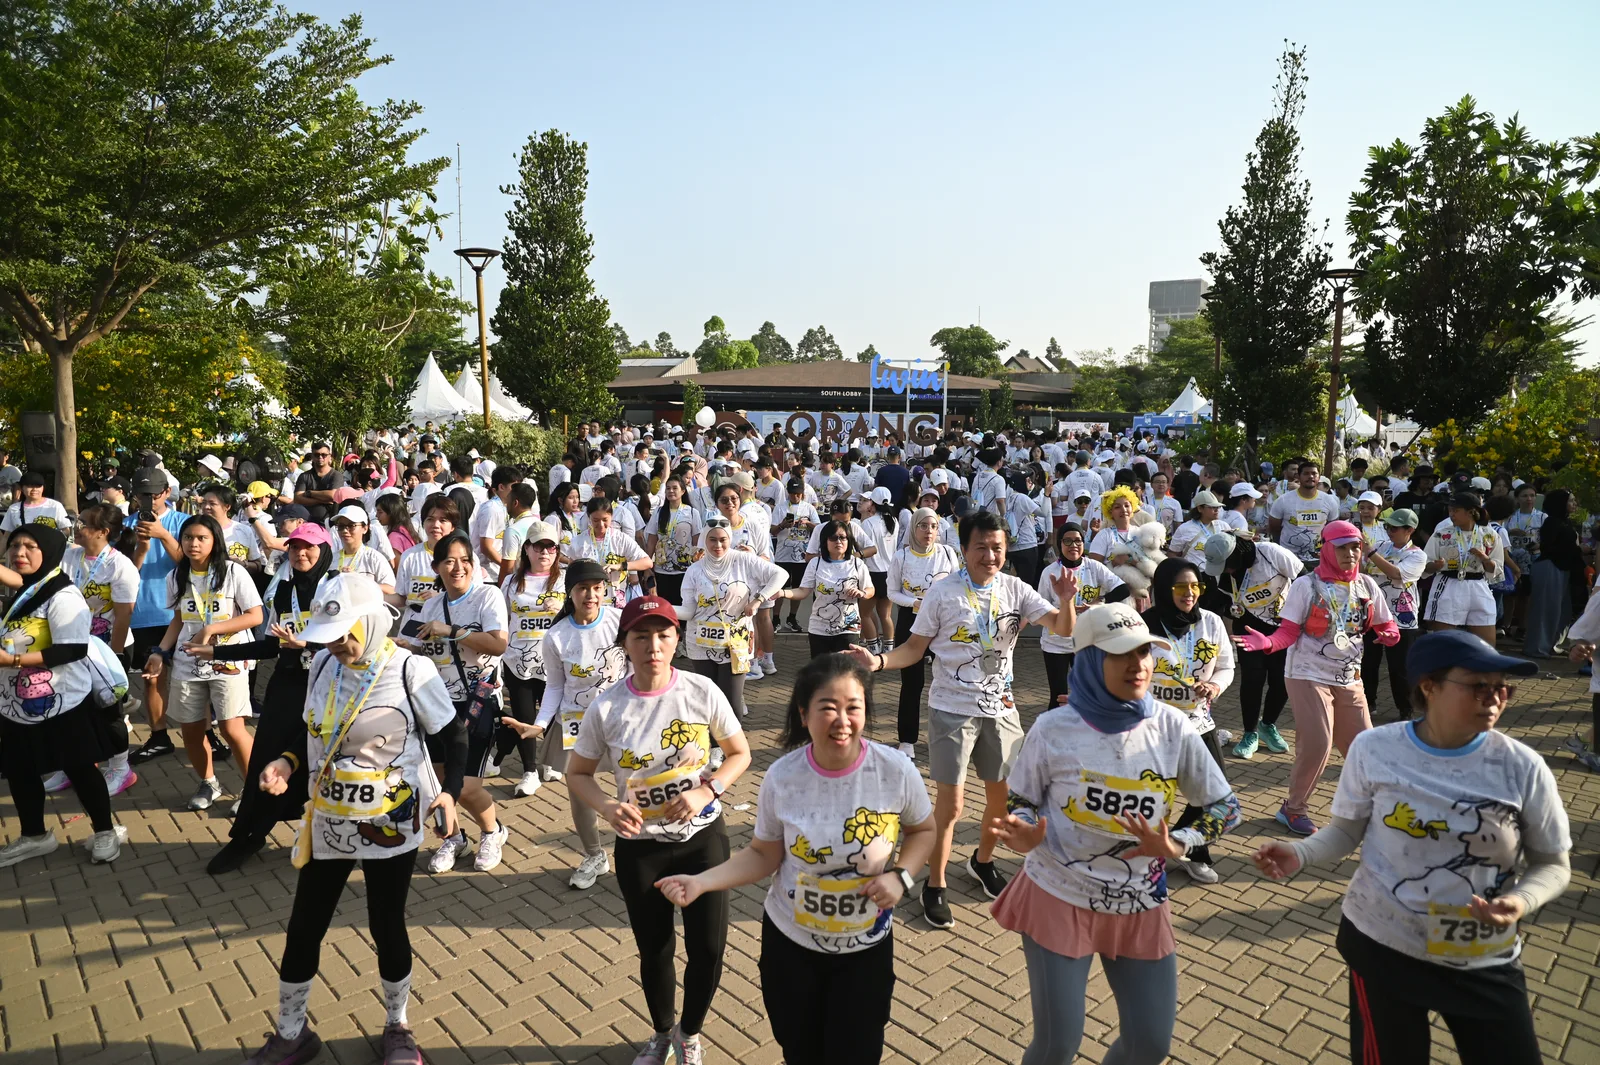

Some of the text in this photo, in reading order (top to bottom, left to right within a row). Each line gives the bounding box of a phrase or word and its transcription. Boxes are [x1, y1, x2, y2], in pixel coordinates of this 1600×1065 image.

[1301, 513, 1318, 521] 7311
[1245, 588, 1272, 604] 5109
[521, 618, 551, 630] 6542
[700, 627, 725, 640] 3122
[1153, 685, 1190, 700] 4091
[1085, 786, 1156, 820] 5826
[804, 889, 869, 917] 5667
